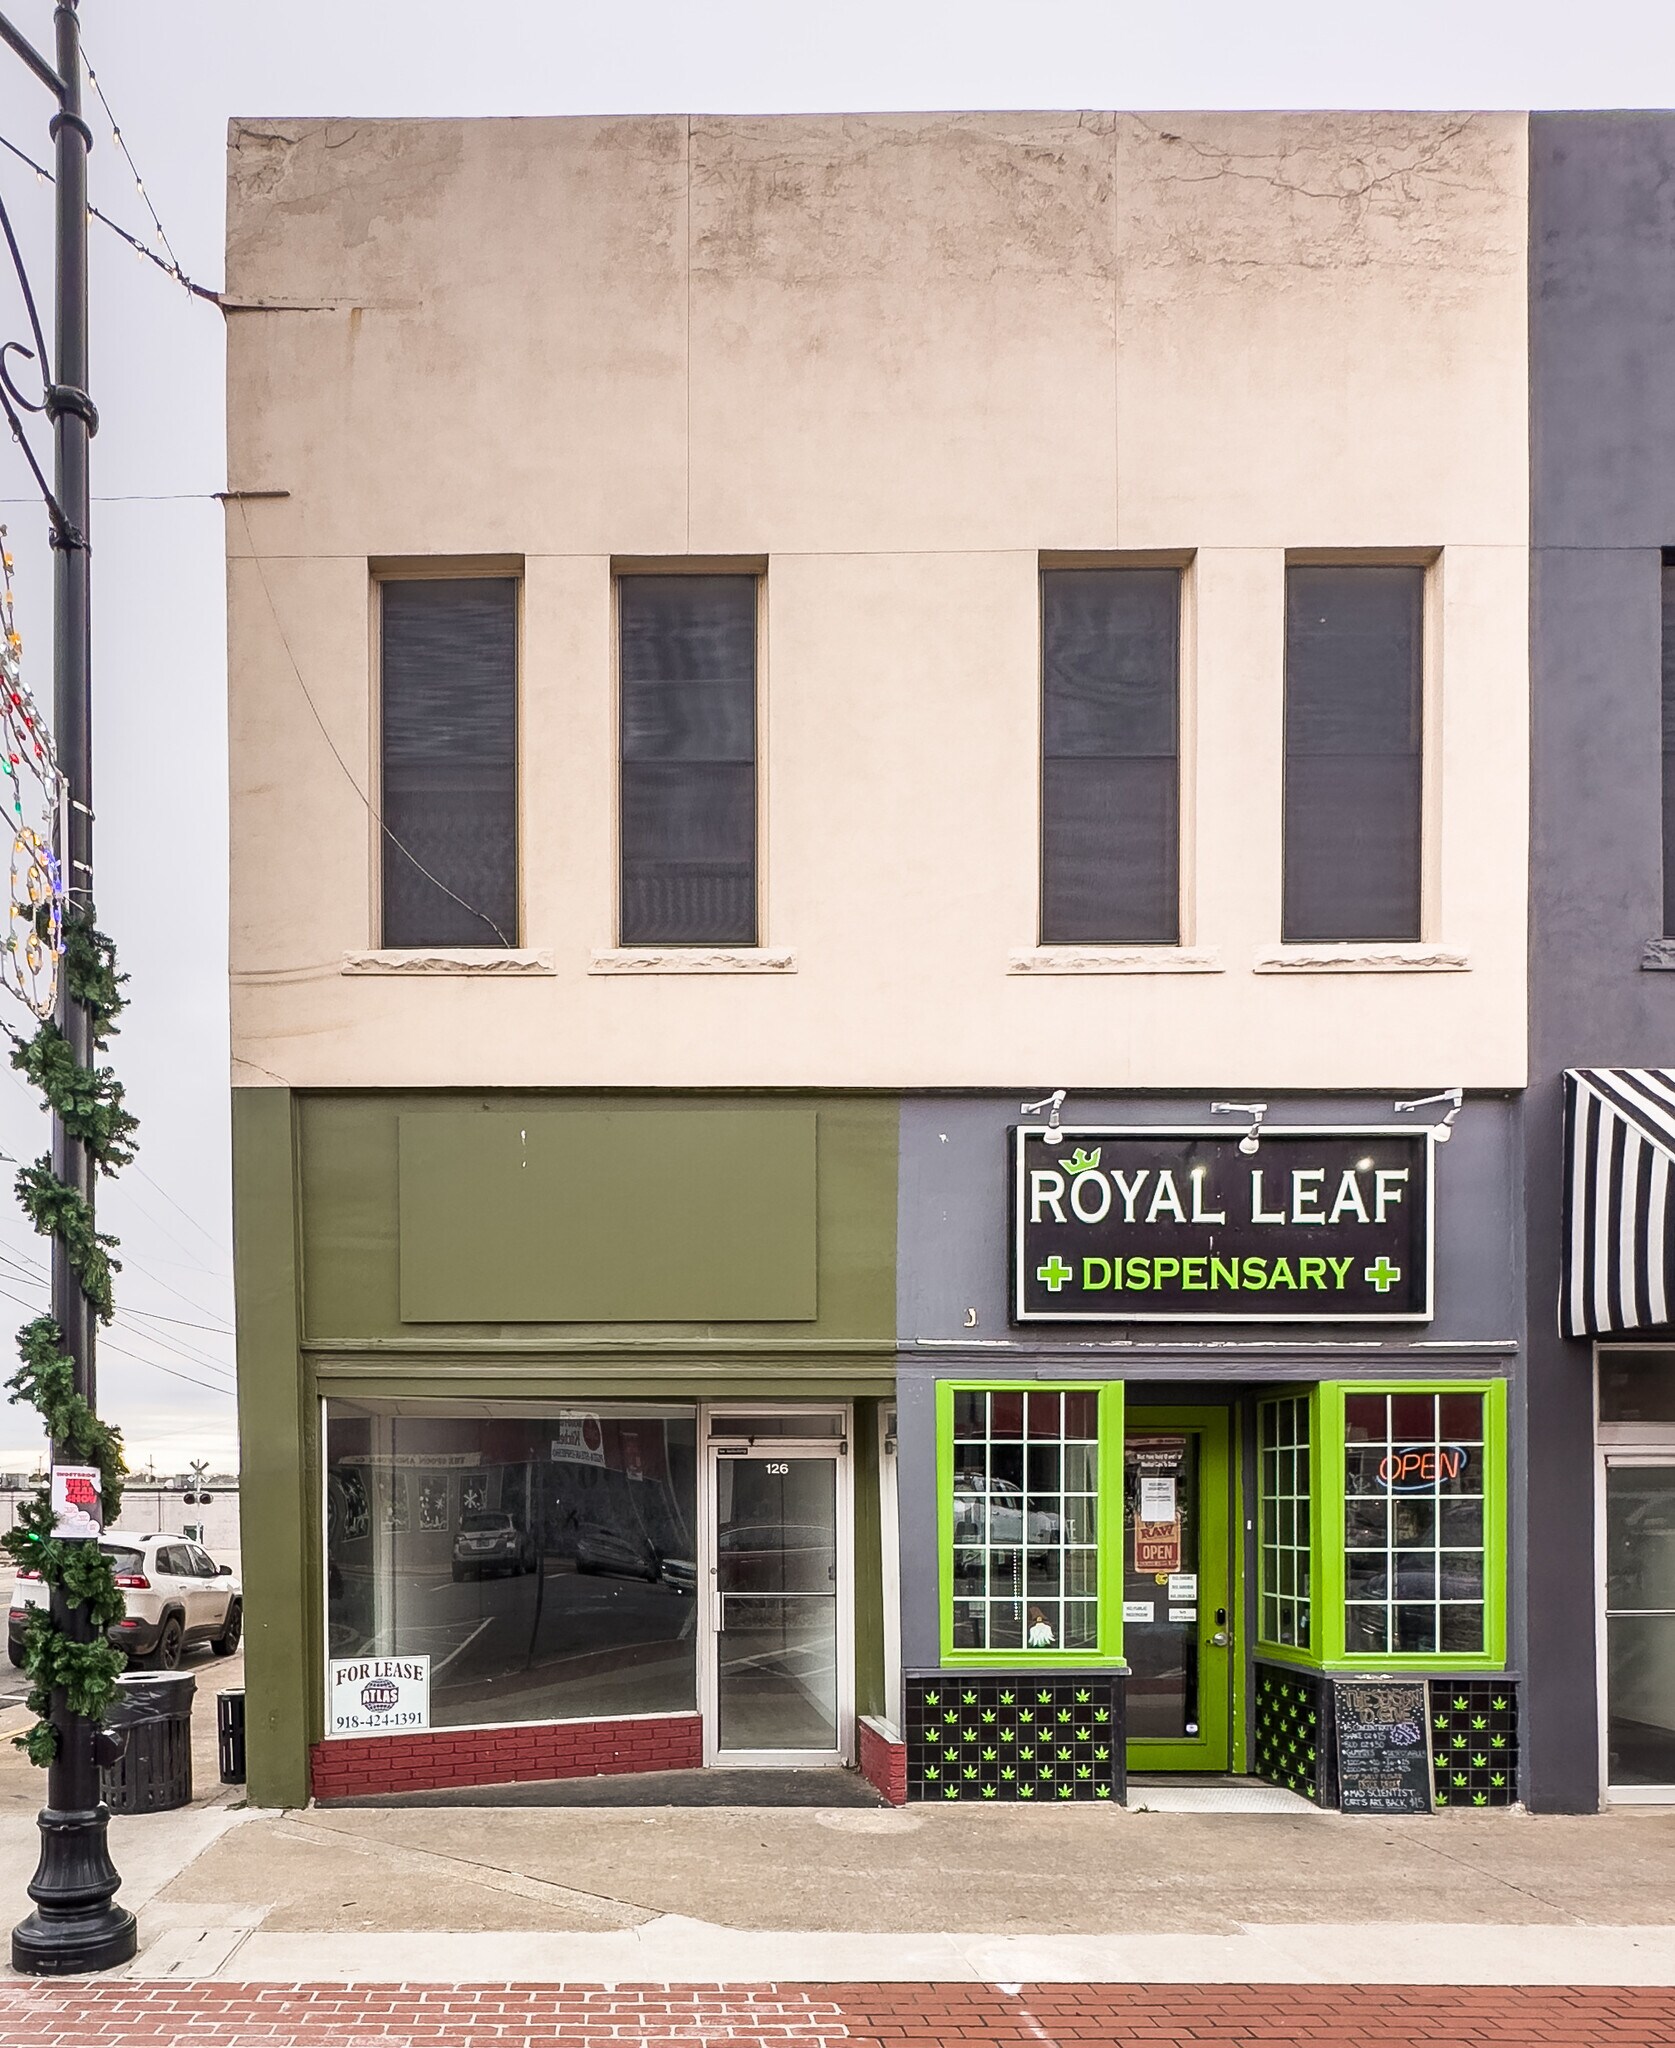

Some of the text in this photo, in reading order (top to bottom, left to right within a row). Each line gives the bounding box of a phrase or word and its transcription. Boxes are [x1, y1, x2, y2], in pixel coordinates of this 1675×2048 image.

[1030, 1168, 1409, 1225] ROYAL LEAF
[1082, 1257, 1354, 1291] DISPENSARY
[765, 1463, 789, 1475] 126
[1379, 1452, 1459, 1480] OPEN
[66, 1479, 91, 1487] NEW
[68, 1487, 94, 1495] YEAR
[66, 1494, 97, 1503] SHOW
[1141, 1525, 1175, 1539] RAW
[1143, 1545, 1172, 1560] OPEN
[336, 1662, 424, 1686] FOR LEASE
[362, 1688, 398, 1704] ATLAS
[337, 1712, 422, 1729] 918-424-1391
[1367, 1788, 1416, 1798] SCIENTIST
[1385, 1799, 1408, 1808] BACK
